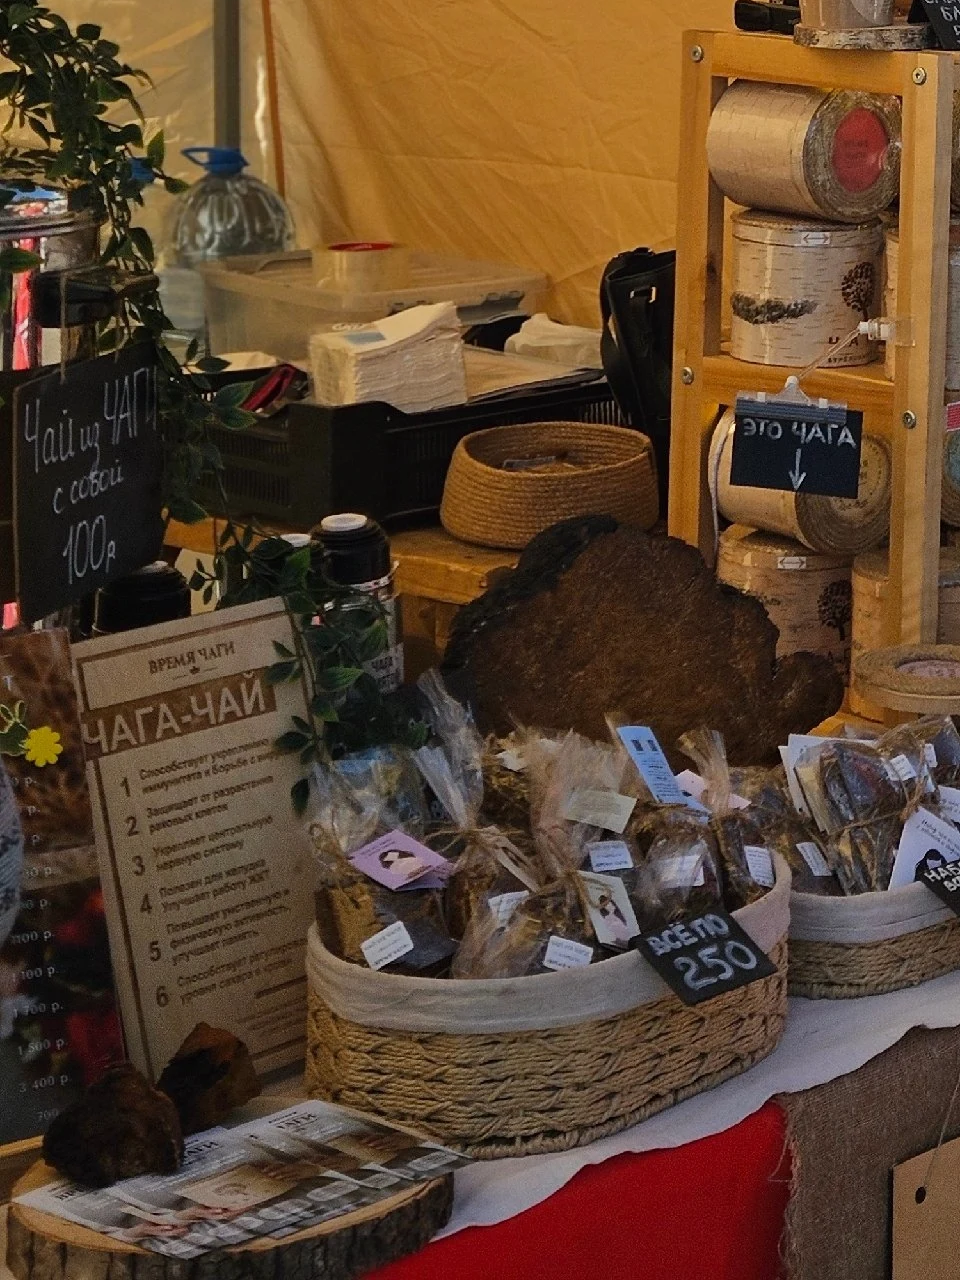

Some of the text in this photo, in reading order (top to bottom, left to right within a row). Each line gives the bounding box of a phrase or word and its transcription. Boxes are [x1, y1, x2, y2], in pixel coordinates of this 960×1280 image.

[743, 417, 857, 450] ЭТО ЧАГА
[149, 640, 236, 674] ВРЕМЯ ЧАГИ
[82, 672, 267, 755] ЧАГА-ЧАЙ
[120, 777, 131, 797] 1
[124, 816, 140, 838] 2
[132, 855, 146, 876] 3
[140, 894, 153, 915] 4
[646, 913, 729, 957] ВСЁ ПО
[149, 941, 162, 962] 5
[673, 940, 758, 991] 250
[156, 986, 170, 1008] 6
